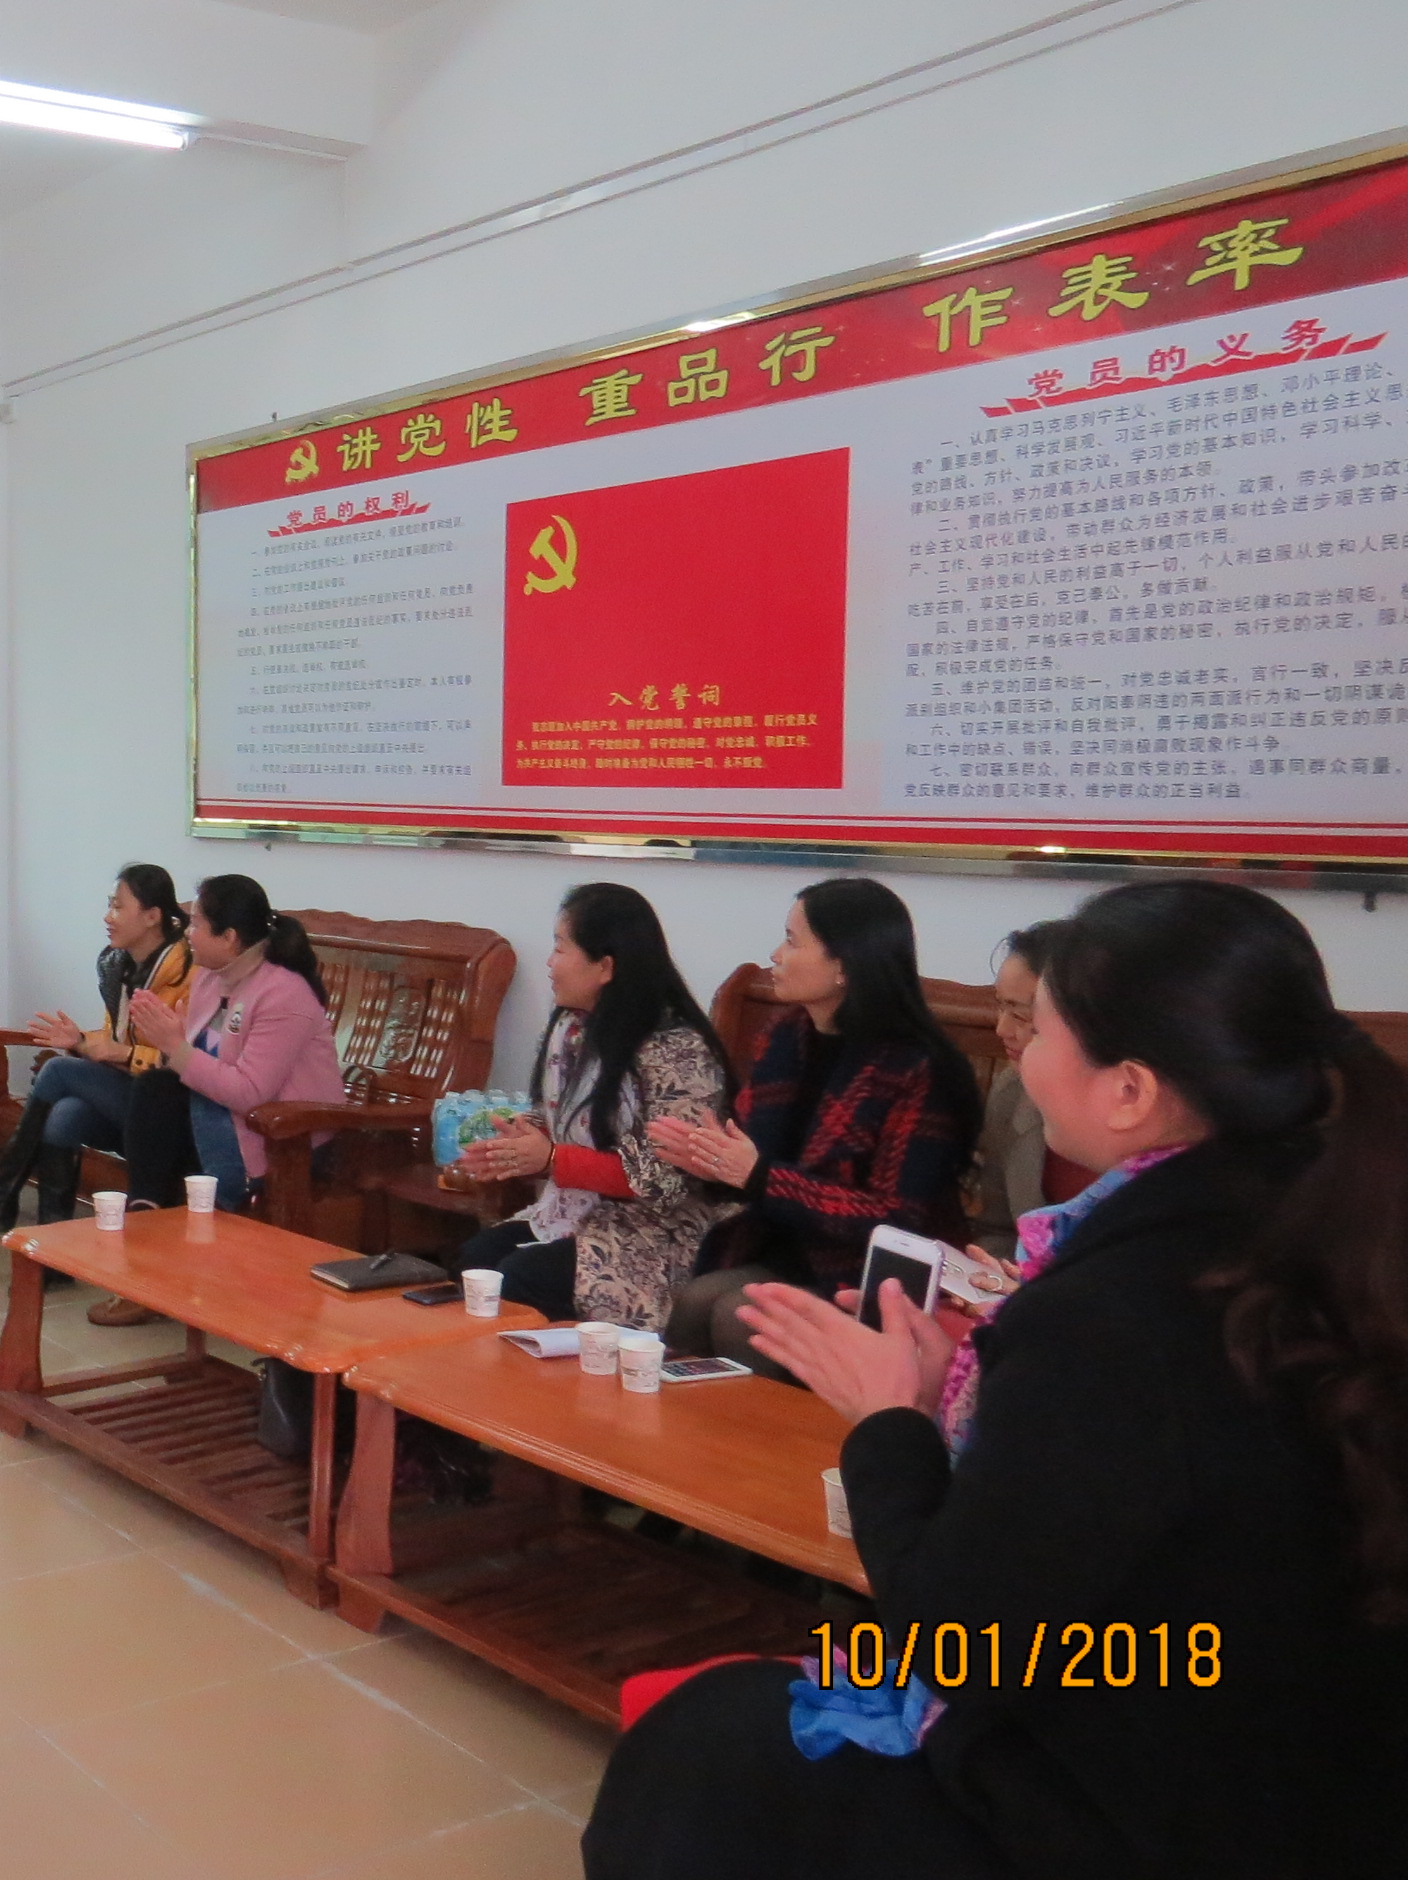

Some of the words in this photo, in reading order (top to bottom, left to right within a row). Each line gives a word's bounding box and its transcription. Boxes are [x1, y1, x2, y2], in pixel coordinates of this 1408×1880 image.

[336, 397, 519, 472] 讲党性
[579, 326, 835, 427] 重品行
[923, 218, 1303, 352] 作表率
[1027, 316, 1328, 399] 党员的义务
[286, 490, 410, 528] 党员的权利
[607, 683, 721, 711] 入党誓词
